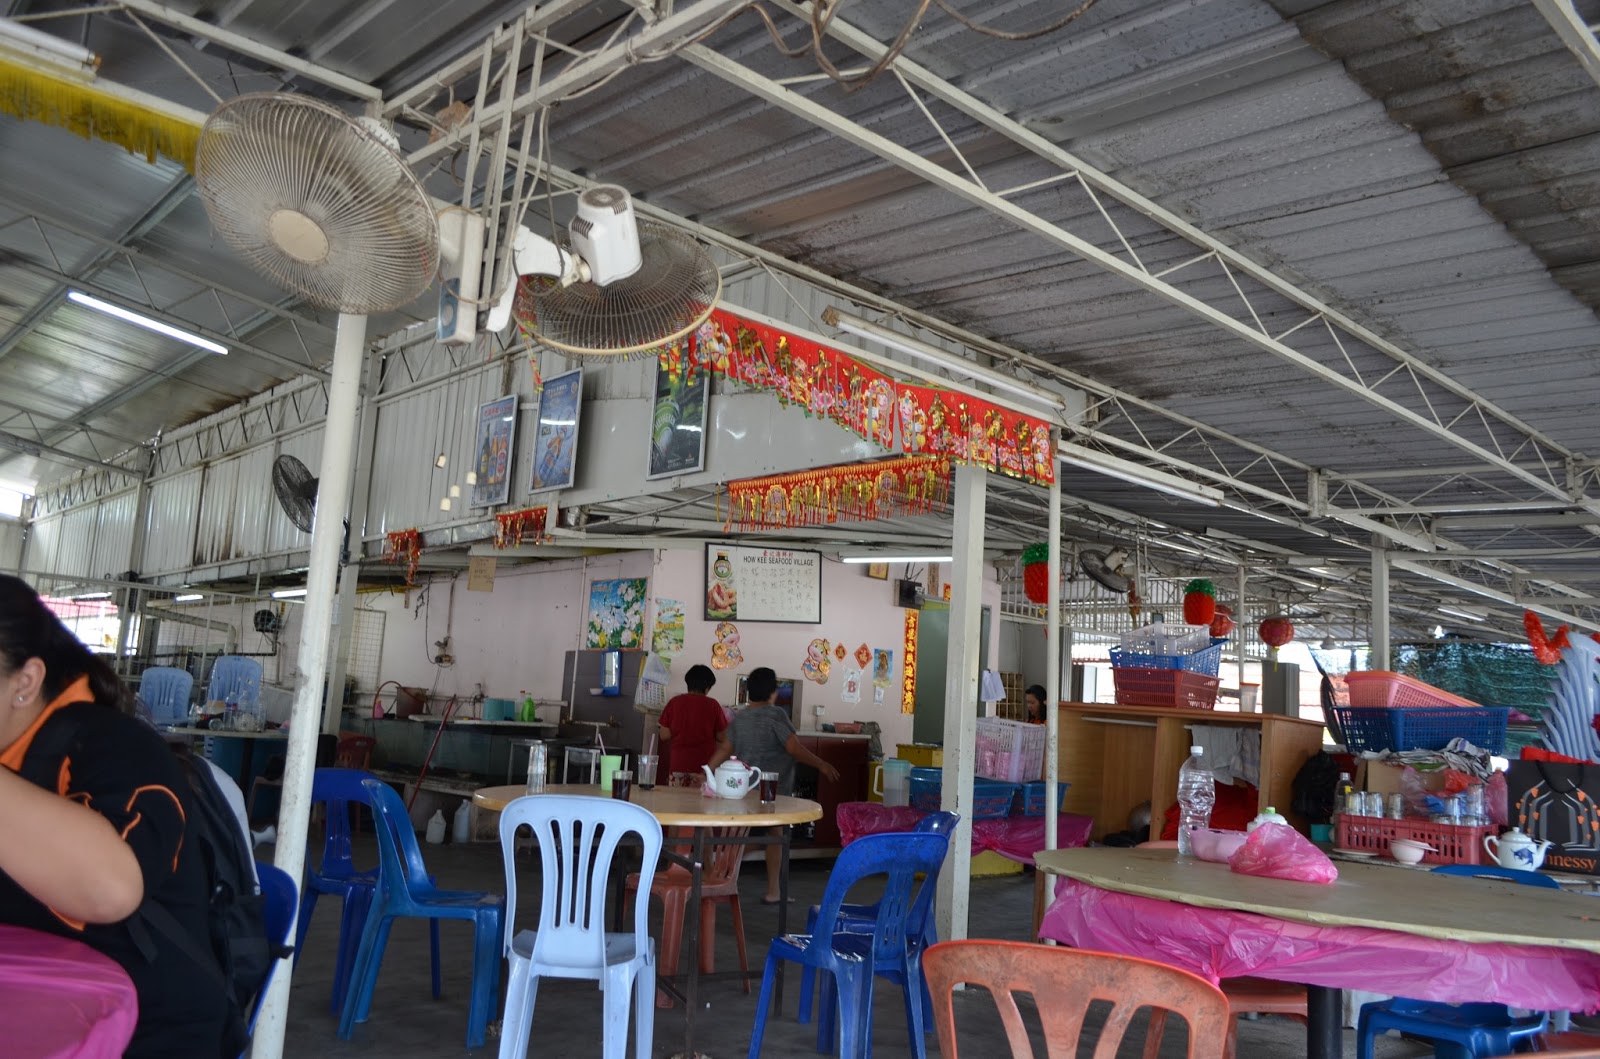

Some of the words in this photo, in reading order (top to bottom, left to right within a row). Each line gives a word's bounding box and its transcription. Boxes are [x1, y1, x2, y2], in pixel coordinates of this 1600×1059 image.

[743, 555, 756, 563] HOW
[757, 556, 768, 564] KEE
[769, 557, 793, 565] SEAFOOD
[794, 558, 814, 566] VILLAGE
[1545, 854, 1597, 872] nnessy
